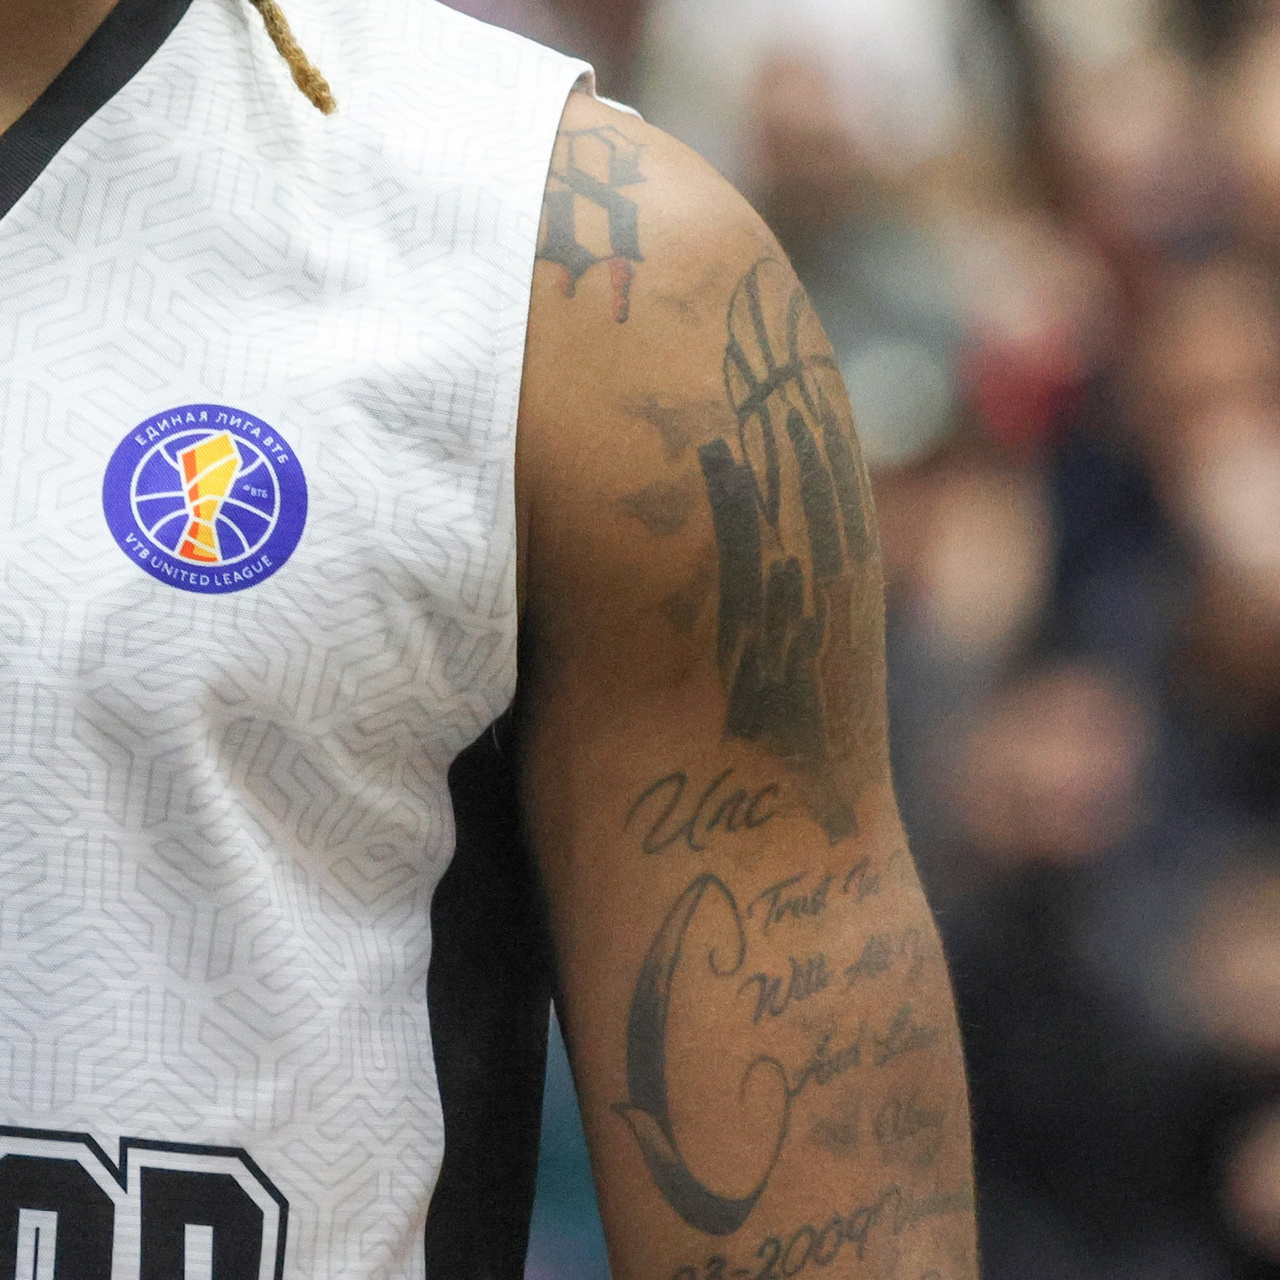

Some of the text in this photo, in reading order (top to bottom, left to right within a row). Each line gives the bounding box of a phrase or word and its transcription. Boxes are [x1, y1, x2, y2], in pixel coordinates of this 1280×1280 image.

[134, 410, 289, 465] ЕДИНАЯ ЛИГА ВТБ
[125, 532, 274, 587] VTB UNITED LEAGUE
